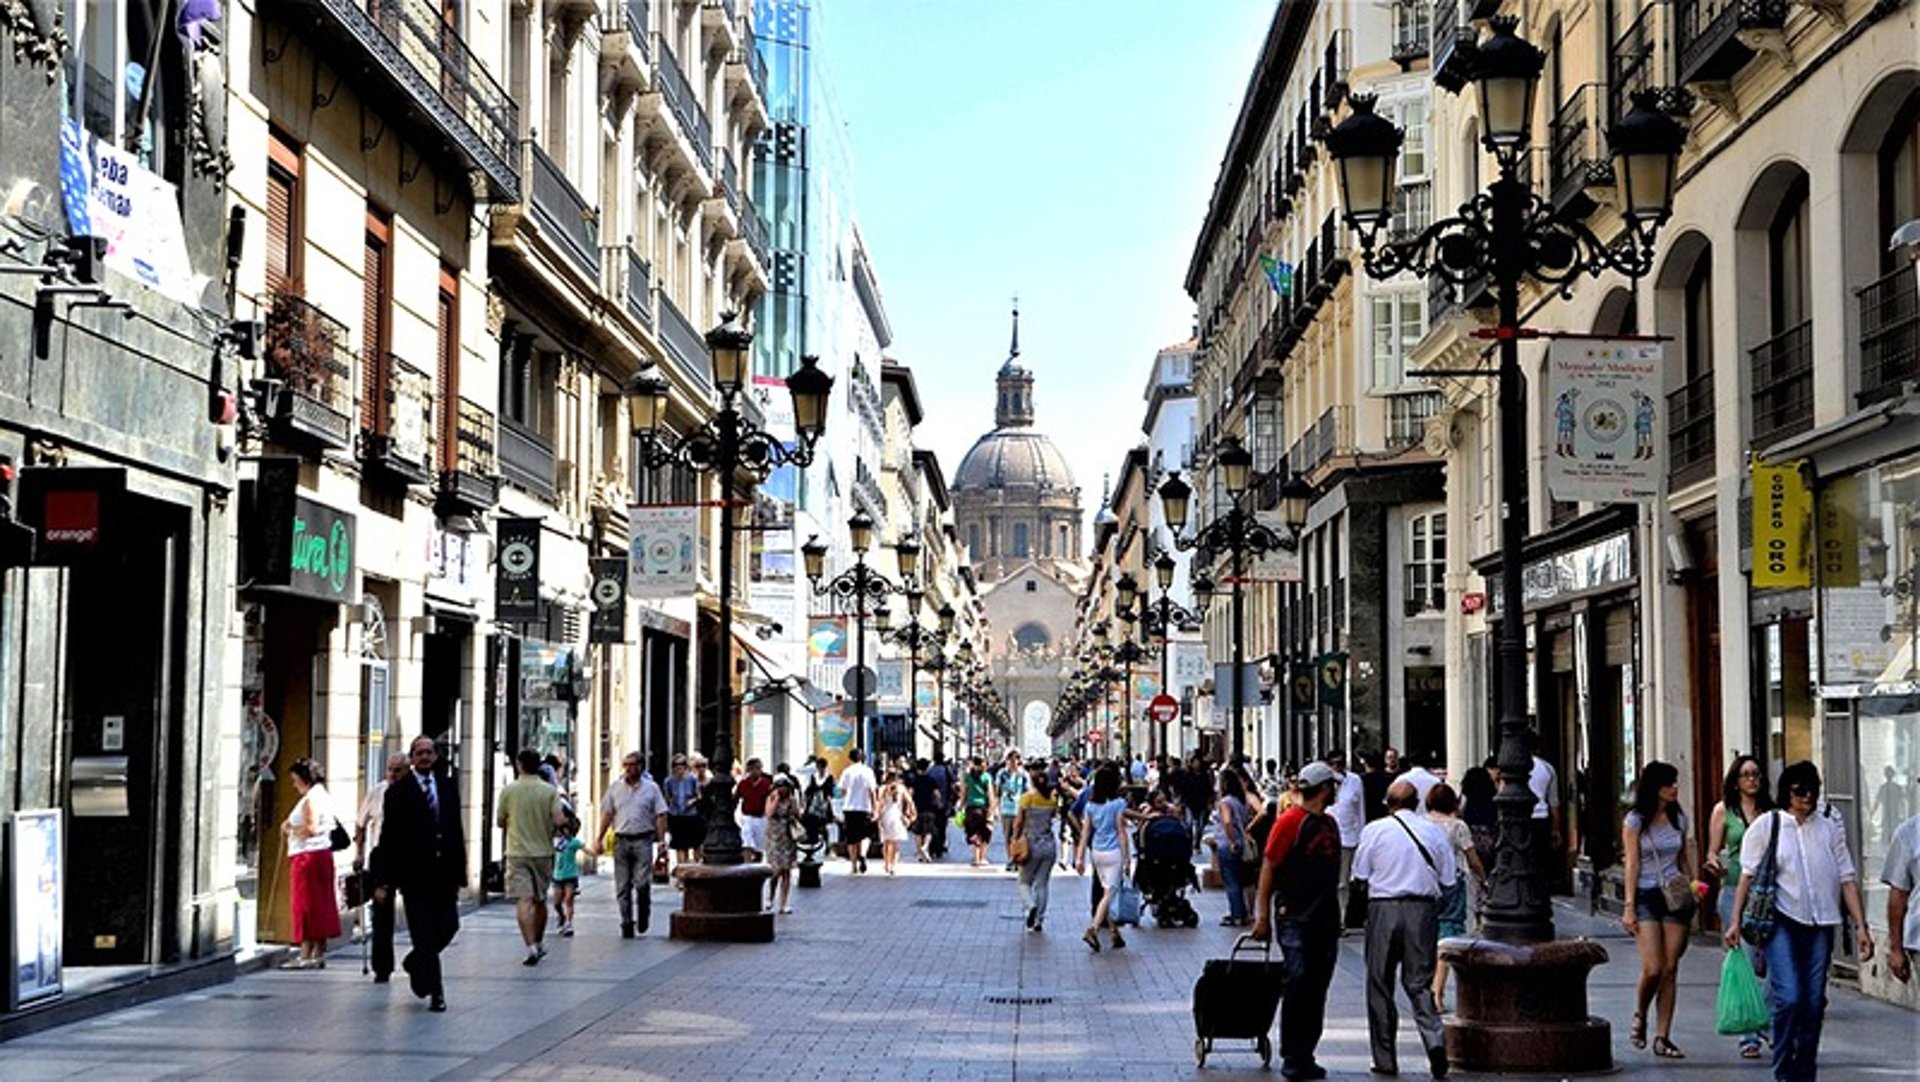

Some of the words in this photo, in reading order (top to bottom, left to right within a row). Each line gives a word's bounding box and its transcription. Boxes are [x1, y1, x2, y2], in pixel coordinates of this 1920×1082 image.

[1770, 474, 1784, 528] COMPRO
[45, 529, 93, 543] orange
[1768, 539, 1787, 574] ORO
